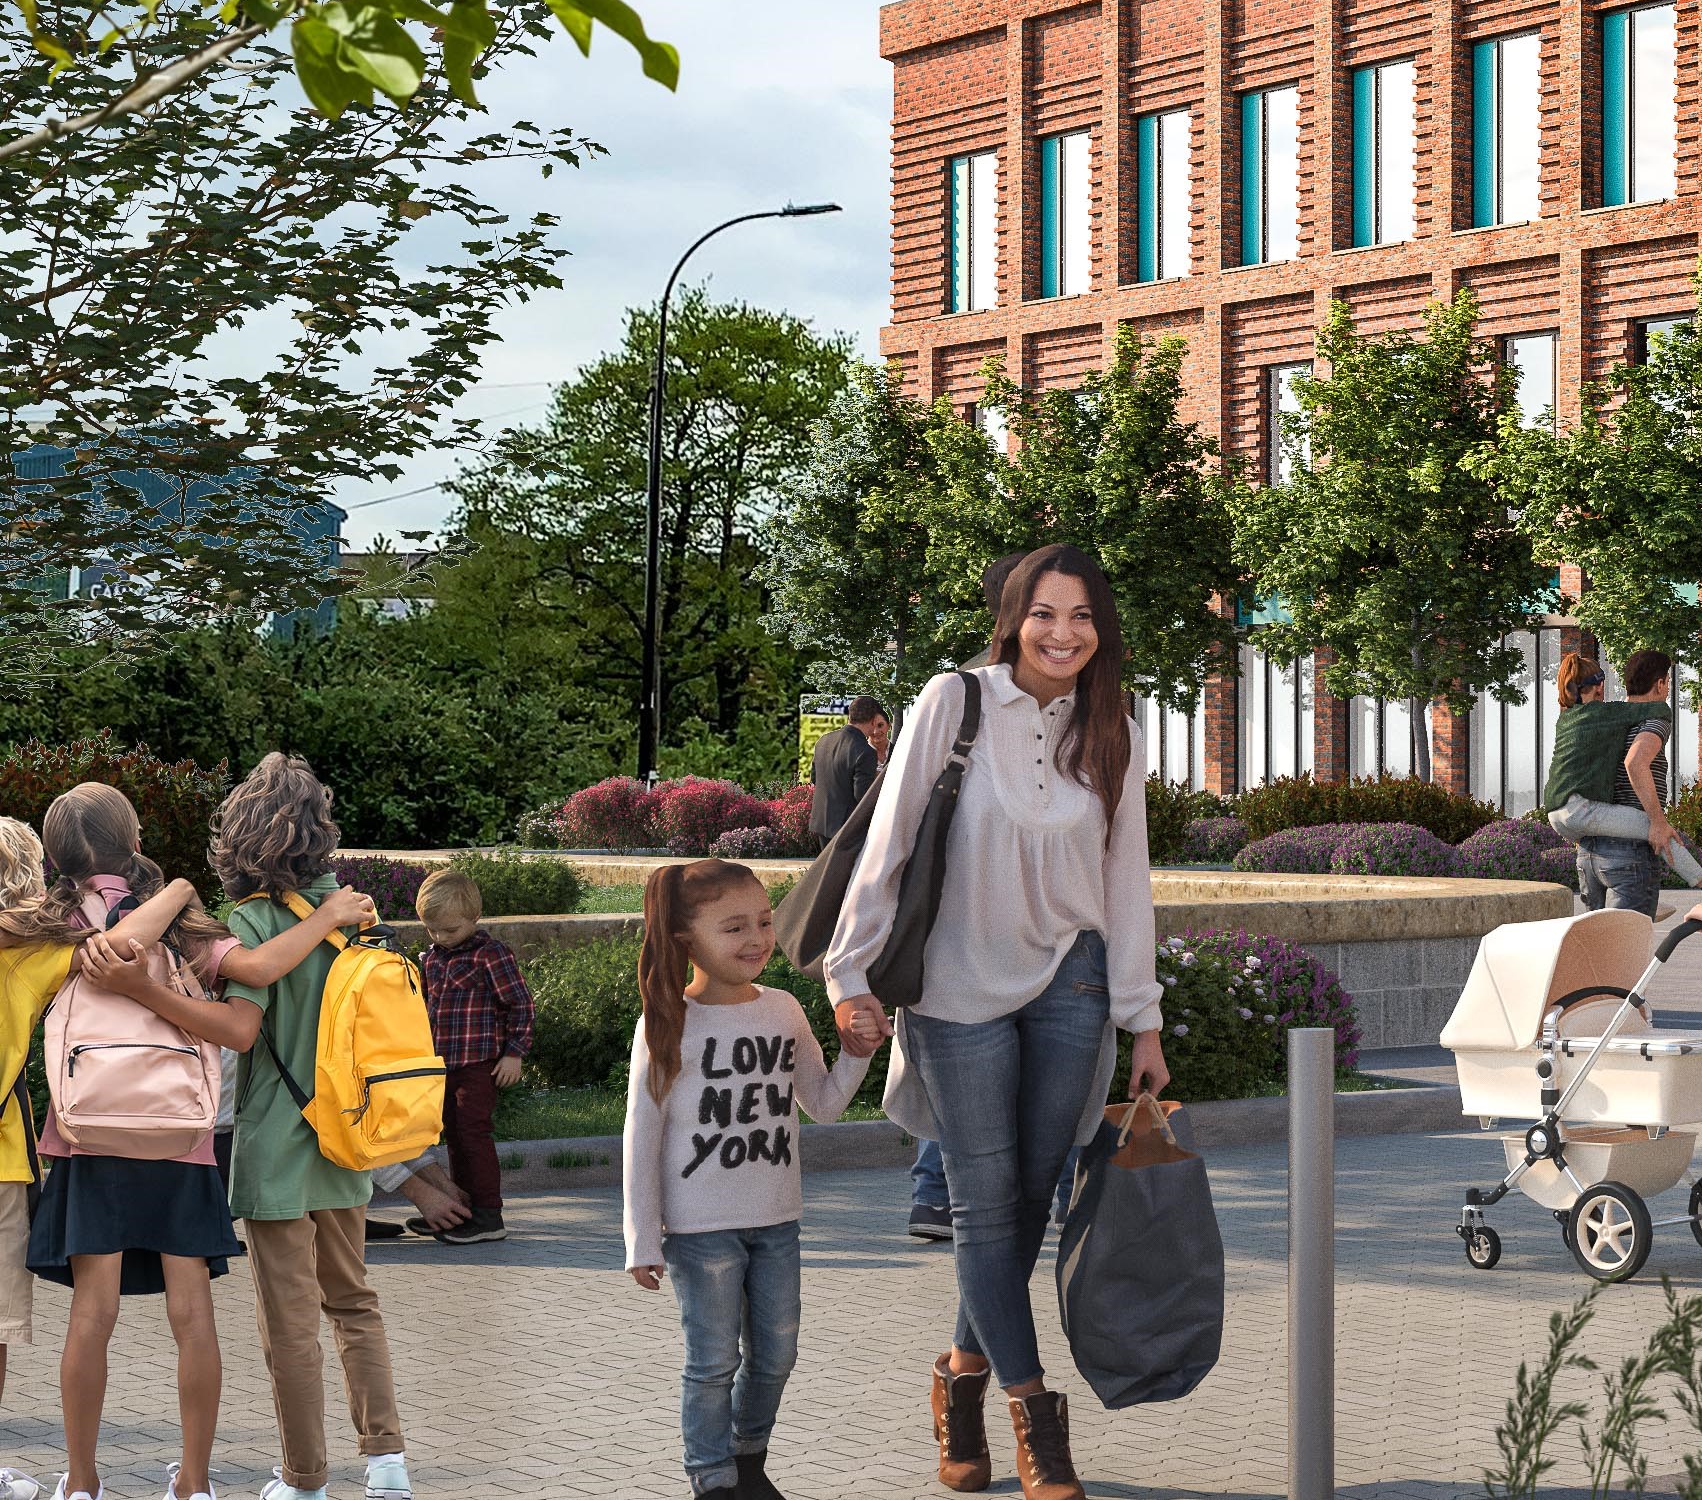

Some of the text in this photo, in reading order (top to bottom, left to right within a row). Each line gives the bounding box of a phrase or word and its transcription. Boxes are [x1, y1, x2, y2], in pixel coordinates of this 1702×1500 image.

[701, 1035, 796, 1079] LOVE
[698, 1082, 793, 1128] NEW
[681, 1125, 791, 1179] YORK
